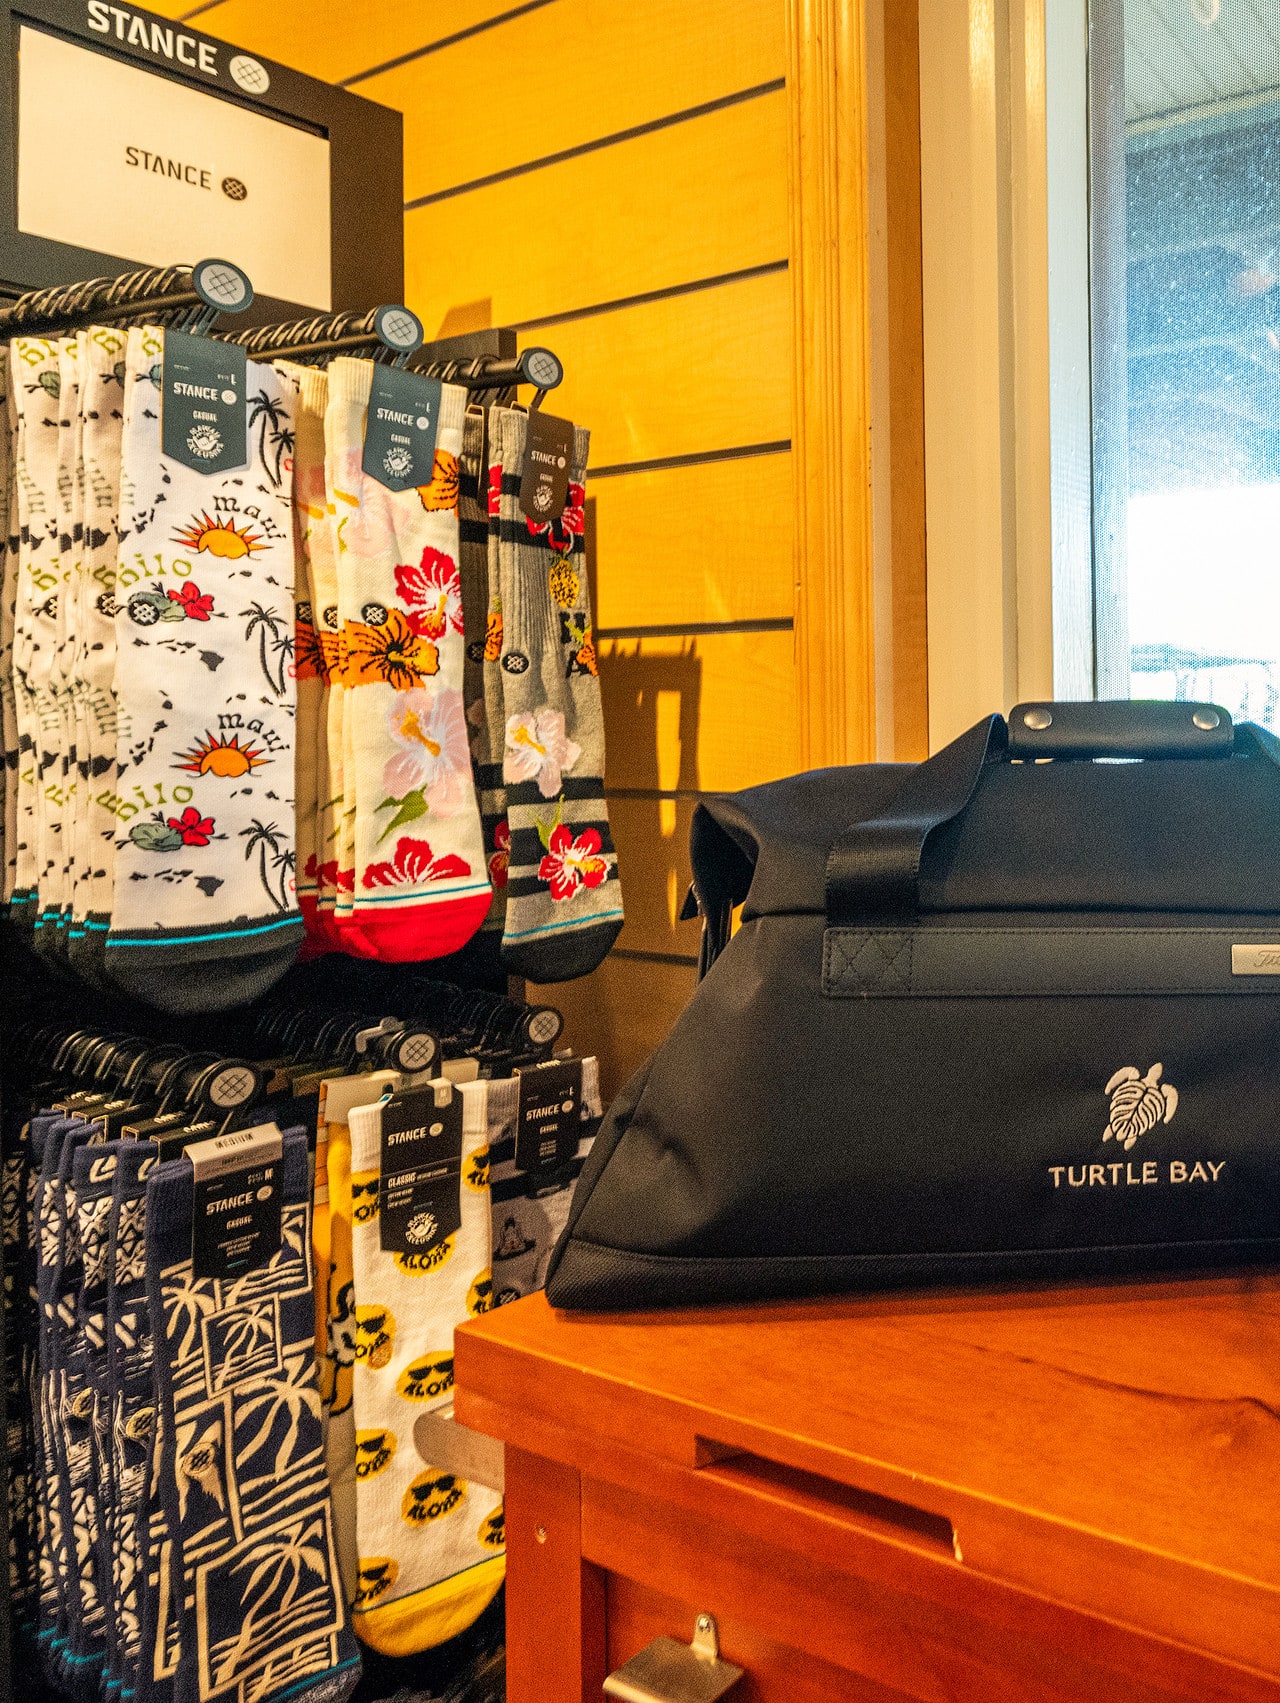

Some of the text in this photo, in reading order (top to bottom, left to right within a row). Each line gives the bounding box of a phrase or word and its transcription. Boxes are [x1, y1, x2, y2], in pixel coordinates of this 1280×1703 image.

[87, 0, 219, 77] STANCE
[125, 145, 212, 191] STANCE
[173, 381, 218, 402] STANCE
[192, 409, 218, 423] CASUAL
[376, 407, 415, 427] STANCE
[530, 449, 557, 466] STANCE
[212, 494, 287, 541] maui
[216, 712, 291, 754] maui
[526, 1103, 561, 1122] STANCE
[387, 1126, 428, 1147] STANCE
[387, 1171, 418, 1190] CLASSIC
[1048, 1159, 1227, 1189] TURTLE BAY
[206, 1190, 254, 1216] STANCE
